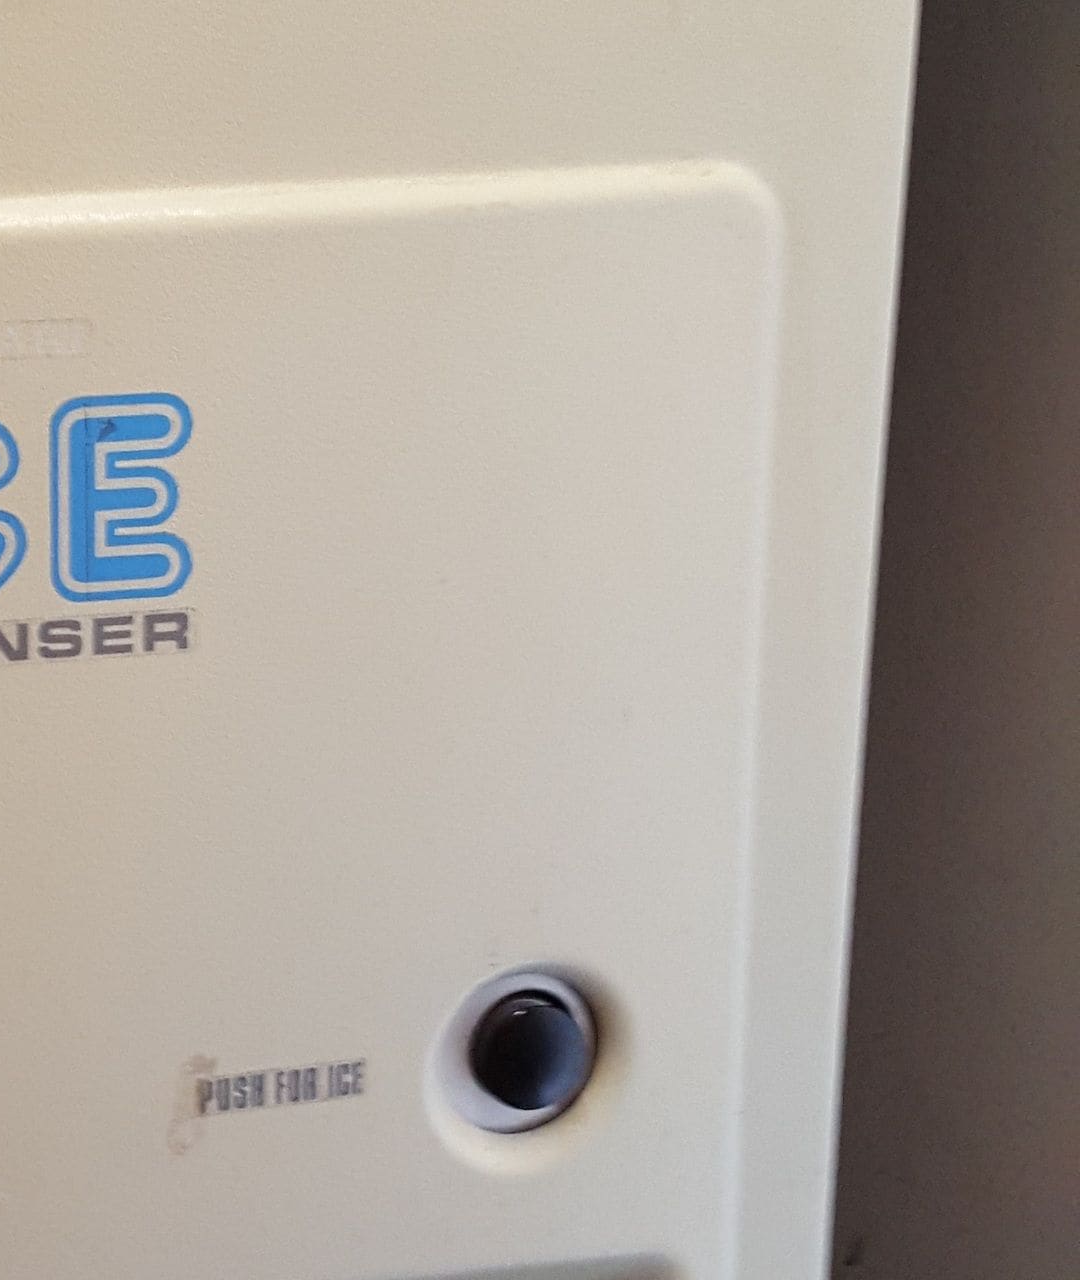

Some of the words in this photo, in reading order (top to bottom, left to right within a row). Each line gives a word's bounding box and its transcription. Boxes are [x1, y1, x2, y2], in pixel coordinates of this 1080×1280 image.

[199, 1074, 265, 1114] PUSH
[275, 1067, 317, 1105] FOR
[329, 1062, 364, 1097] ICE
